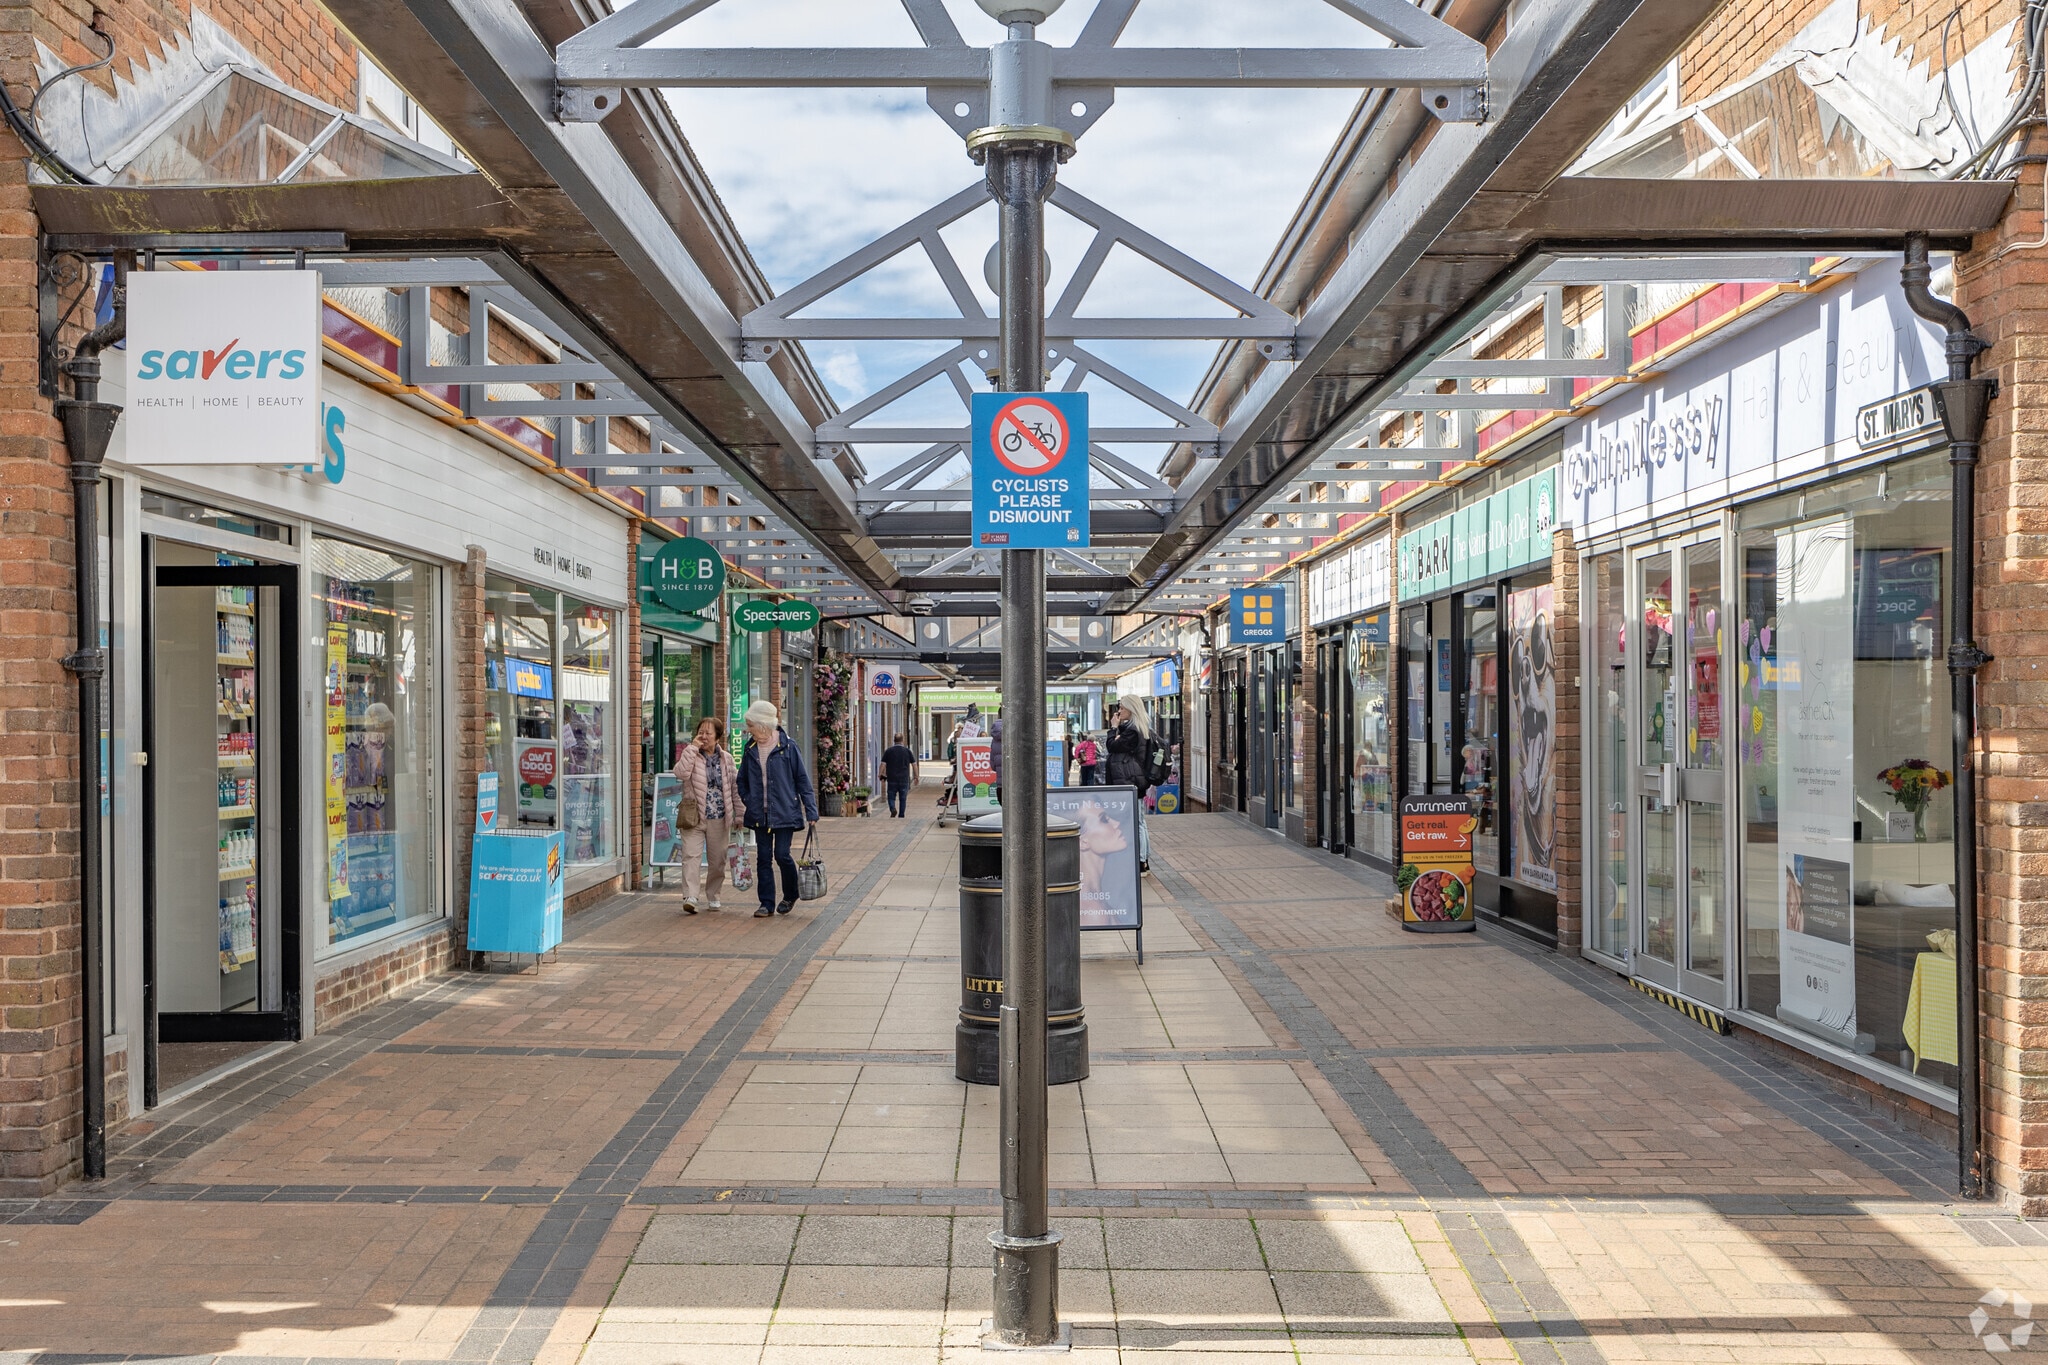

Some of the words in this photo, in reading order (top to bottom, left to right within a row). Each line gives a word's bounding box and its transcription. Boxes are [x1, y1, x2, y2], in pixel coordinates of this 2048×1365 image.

[137, 337, 306, 381] savers
[1797, 351, 1812, 404] &
[1826, 317, 1917, 393] Beauty
[137, 397, 183, 408] HEALTH
[203, 396, 239, 407] HOME
[258, 396, 304, 407] BEAUTY
[1863, 410, 1880, 441] ST.
[992, 478, 1069, 493] CYCLISTS
[999, 494, 1062, 508] PLEASE
[989, 510, 1072, 524] DISMOUNT
[1417, 533, 1450, 581] BARK
[1453, 535, 1467, 563] The
[1468, 519, 1495, 558] Natural
[1496, 519, 1513, 558] Dog
[534, 546, 552, 567] HEALTH
[557, 556, 571, 574] HOME
[576, 563, 592, 581] BEAUTY
[661, 557, 714, 580] H&B
[743, 608, 811, 624] Specsavers
[1243, 628, 1273, 636] GREGGS
[871, 686, 897, 696] fone
[733, 678, 743, 722] Lenses
[964, 750, 991, 761] Two
[964, 761, 990, 773] goo
[1046, 773, 1062, 782] AKE
[665, 799, 677, 807] Be
[1406, 820, 1425, 830] Get
[1427, 820, 1449, 829] real.
[1406, 831, 1426, 840] Get
[1427, 832, 1448, 840] raw.
[498, 864, 519, 873] always
